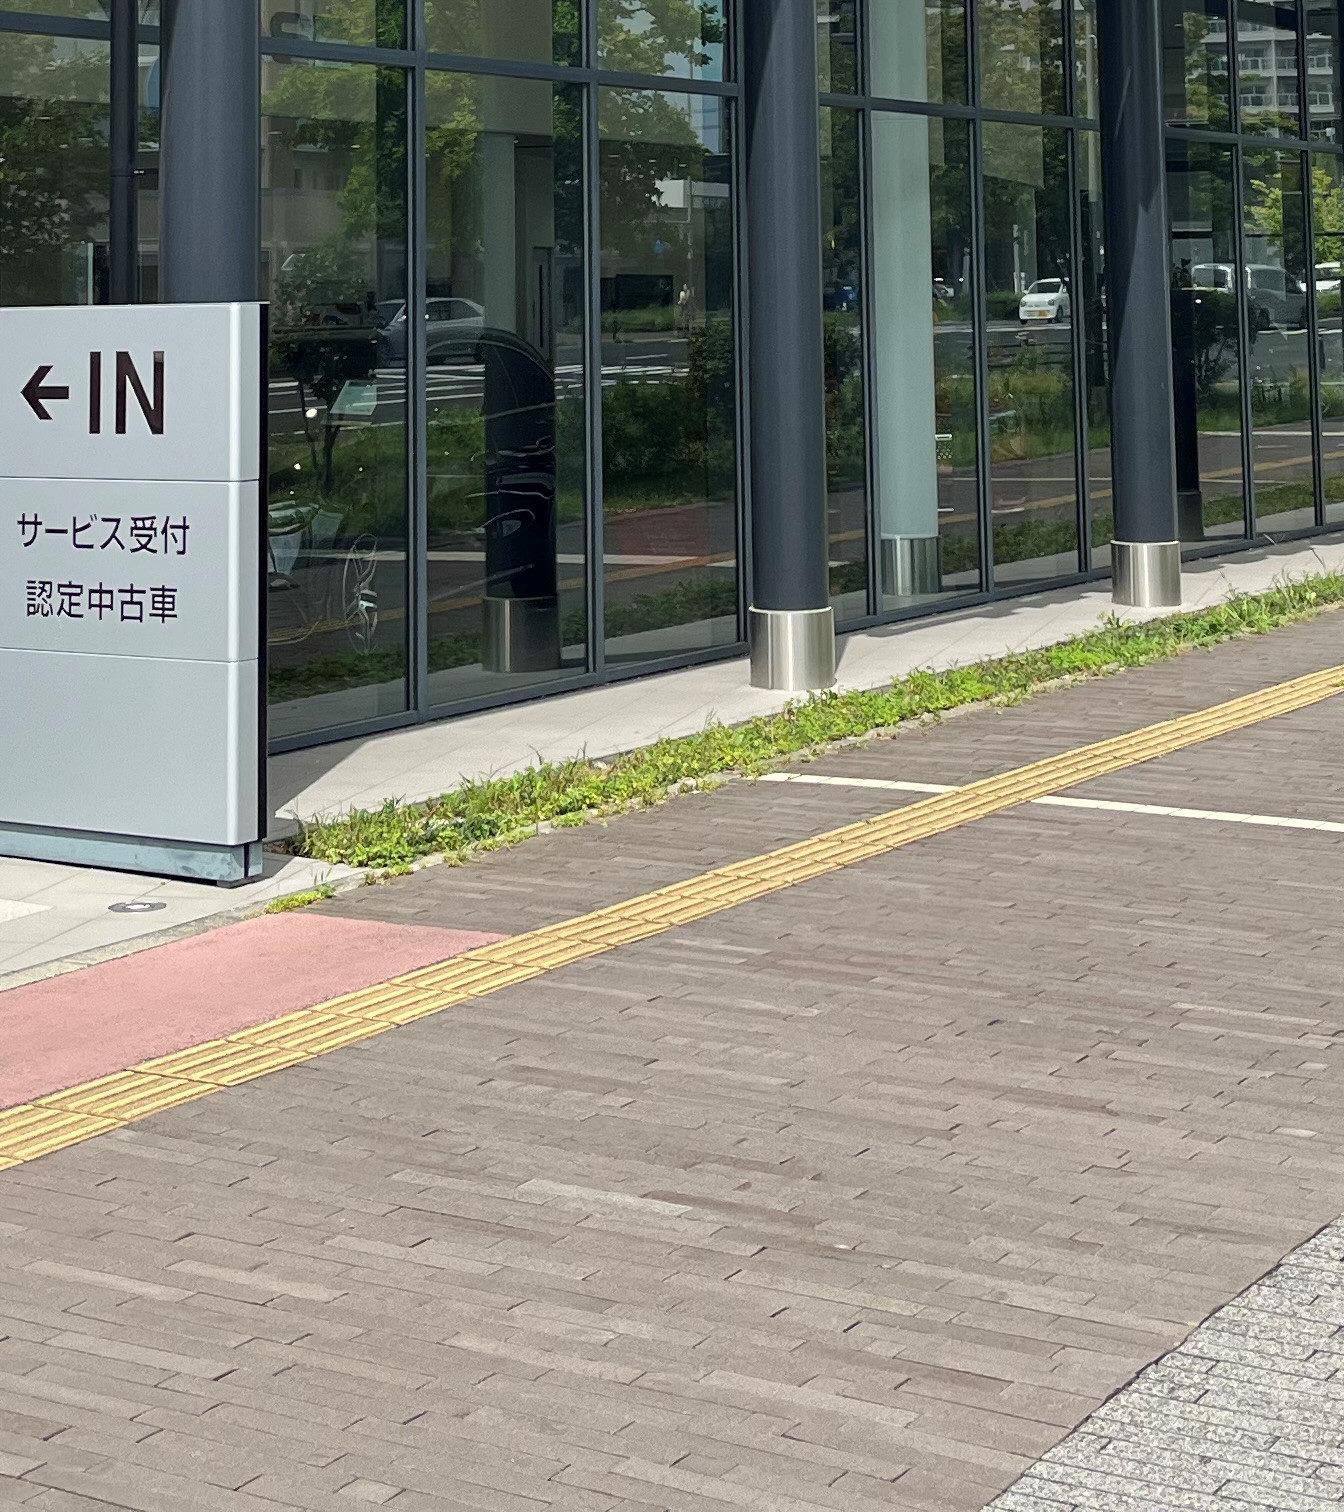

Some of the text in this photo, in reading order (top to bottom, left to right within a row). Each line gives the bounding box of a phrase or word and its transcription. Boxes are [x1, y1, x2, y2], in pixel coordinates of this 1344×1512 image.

[89, 351, 165, 435] IN
[17, 513, 190, 556] サービス受付
[26, 580, 178, 624] 認定中古車
